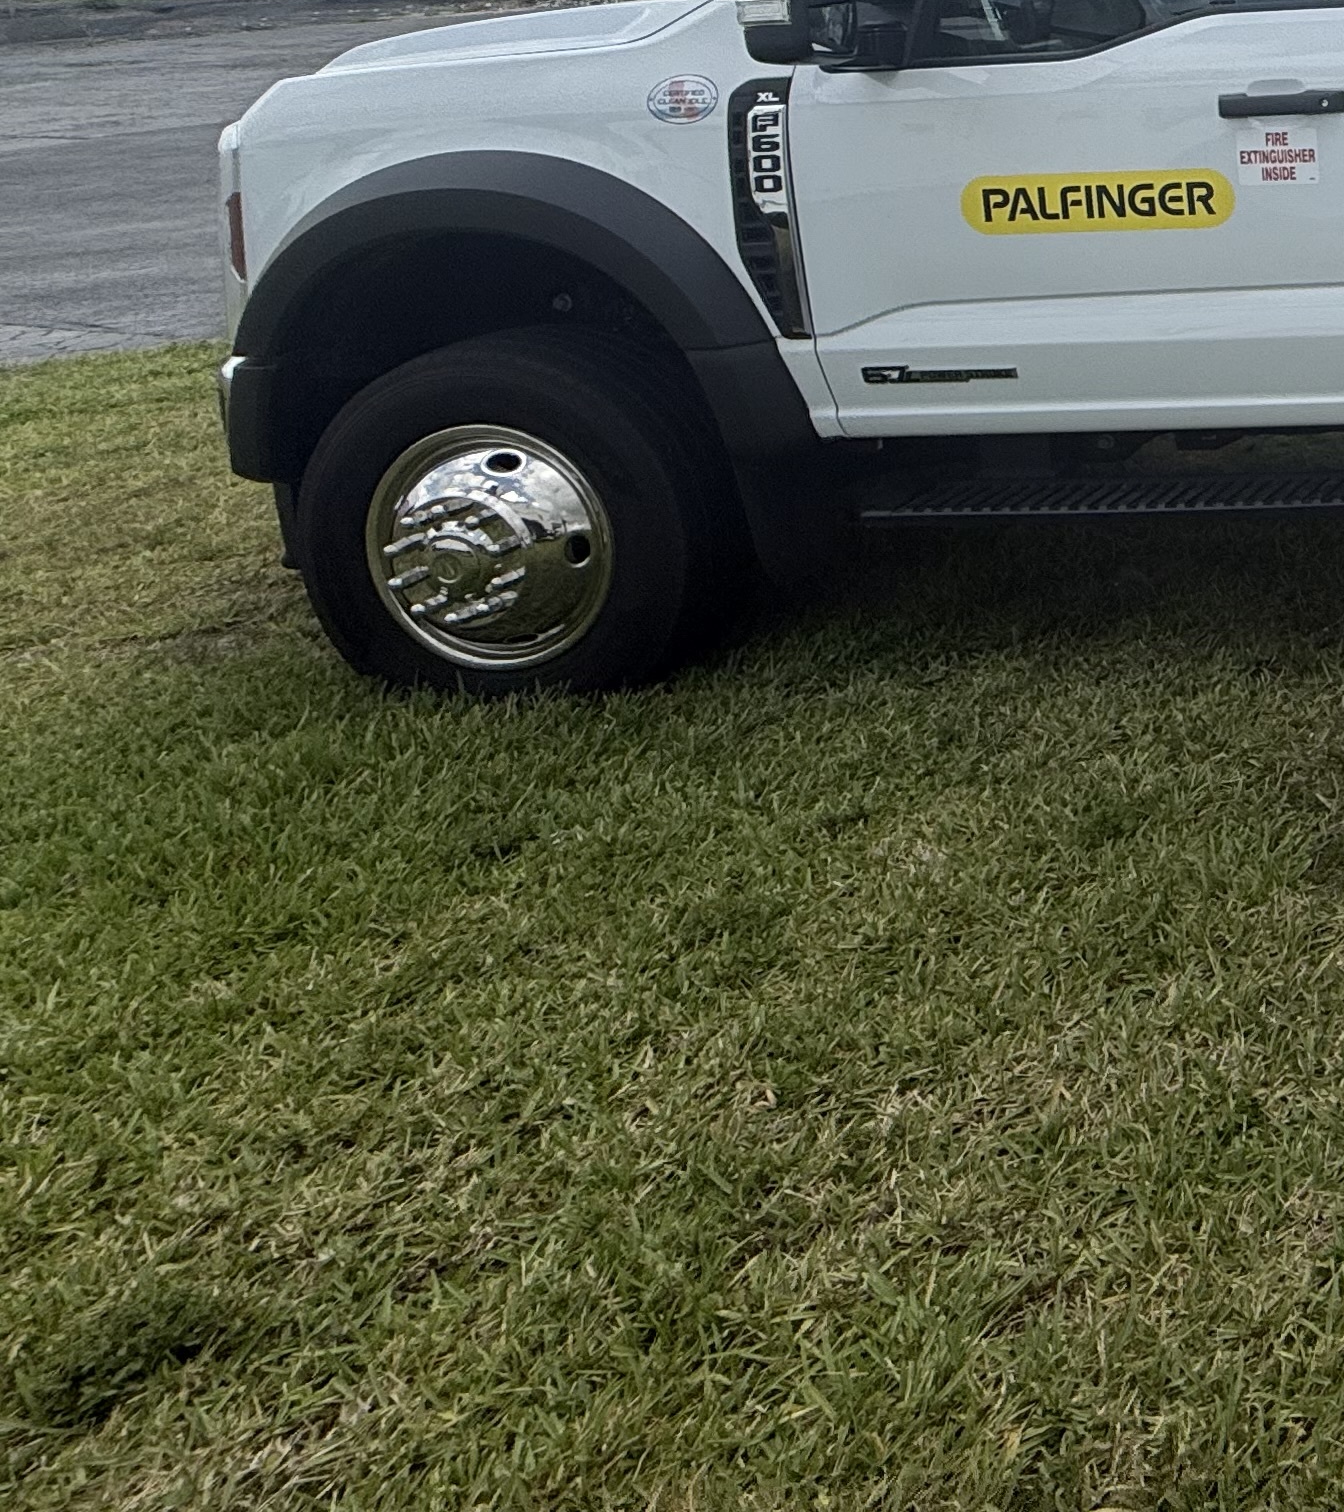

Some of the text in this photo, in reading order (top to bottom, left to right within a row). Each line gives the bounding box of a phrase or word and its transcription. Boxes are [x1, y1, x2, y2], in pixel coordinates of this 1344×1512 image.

[756, 92, 780, 103] XL
[1265, 131, 1289, 147] FIRE
[751, 112, 783, 193] F600
[1239, 148, 1316, 165] EXTINGUISHER
[1261, 166, 1297, 181] INSIDE
[982, 181, 1217, 223] PALFINGER
